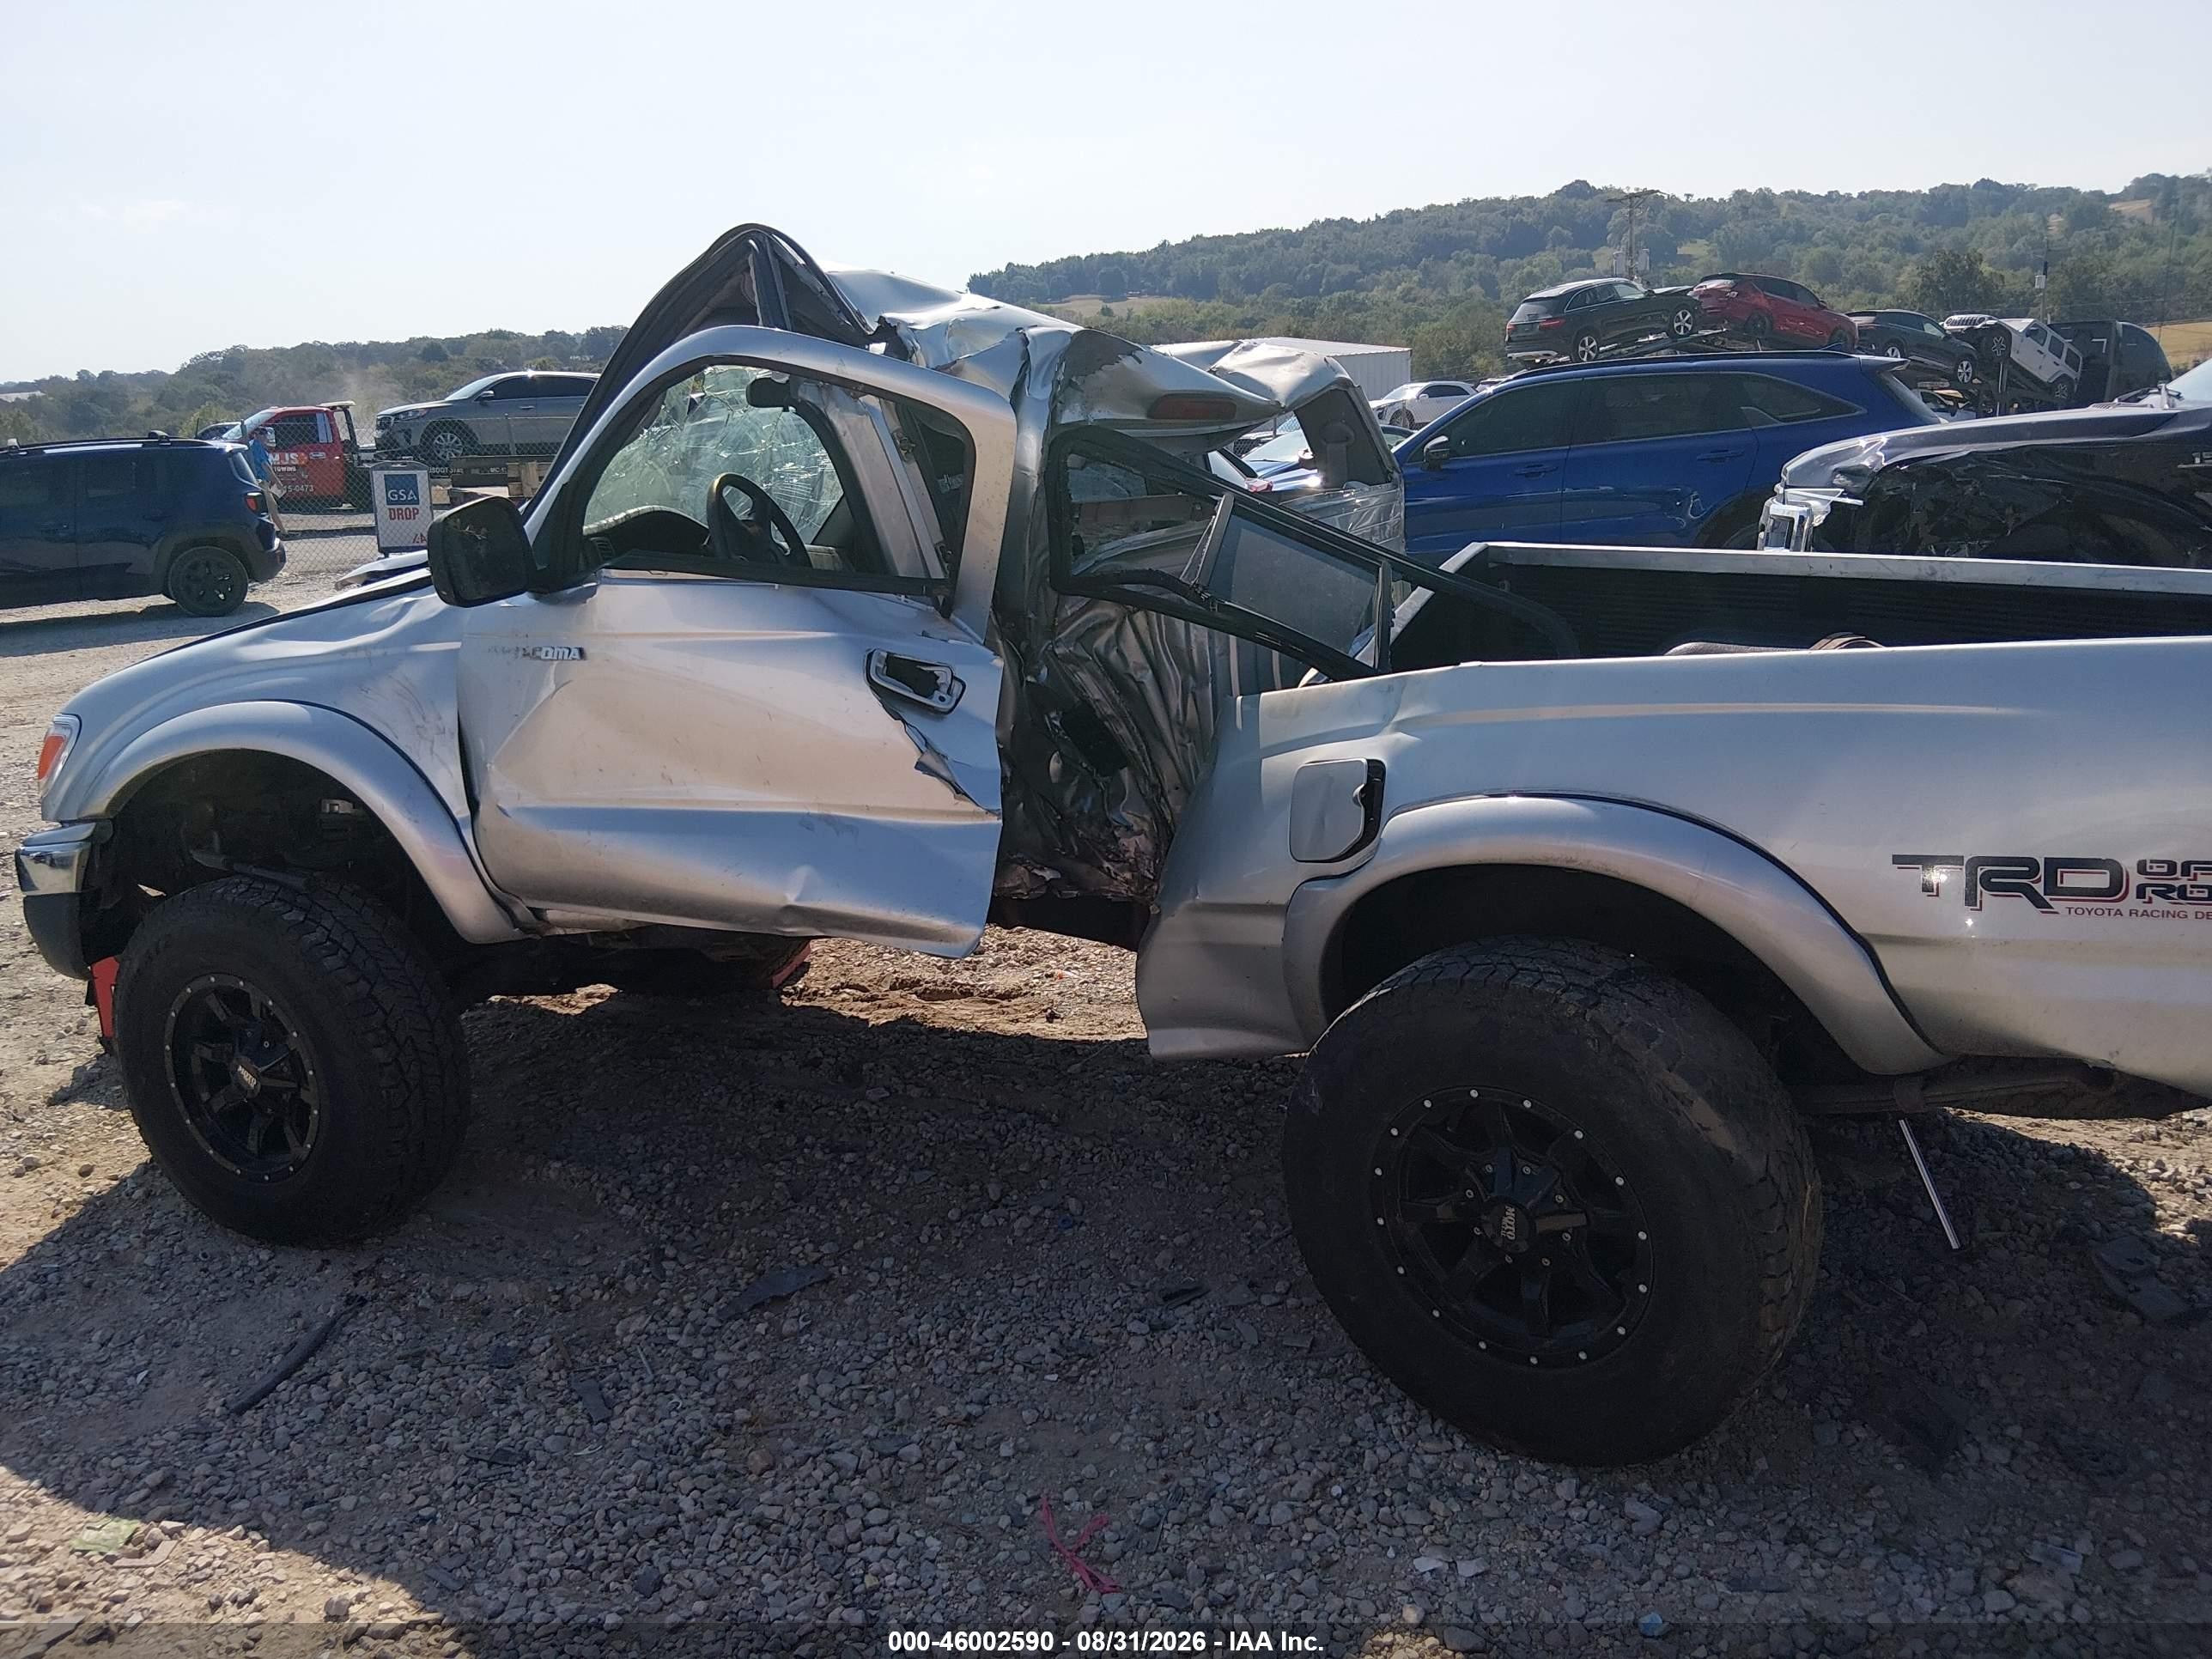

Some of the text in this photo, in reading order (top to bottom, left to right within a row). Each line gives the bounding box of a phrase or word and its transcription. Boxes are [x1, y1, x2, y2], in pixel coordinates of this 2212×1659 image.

[387, 489, 418, 501] GSA
[388, 507, 420, 521] DROP
[1892, 854, 2130, 915] TRD
[2065, 906, 2124, 918] TOYOTA
[2129, 908, 2189, 920] RACING
[1504, 1205, 1516, 1241] MOTO
